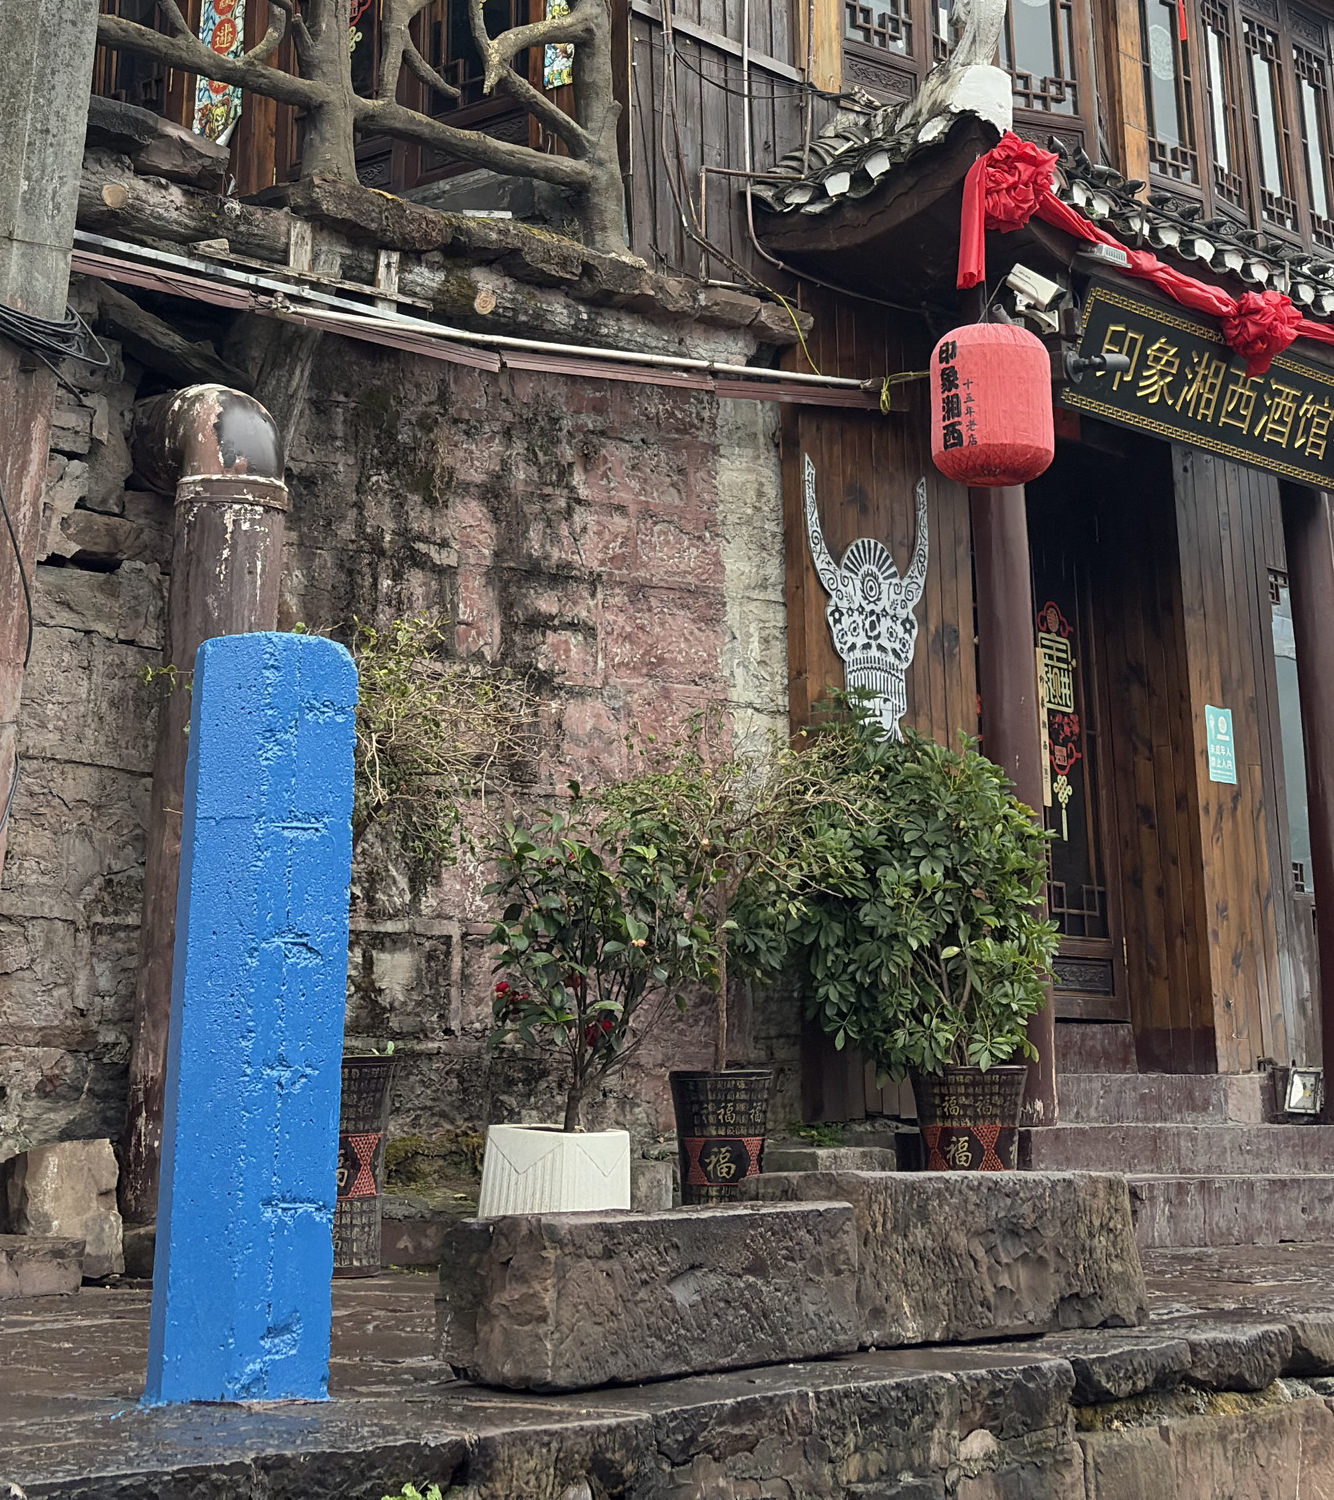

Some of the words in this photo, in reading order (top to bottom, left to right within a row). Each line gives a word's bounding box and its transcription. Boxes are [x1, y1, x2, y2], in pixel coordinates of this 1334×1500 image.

[939, 340, 964, 451] 印象湘西
[962, 378, 978, 447] 十五年老店
[704, 1145, 737, 1180] 福
[945, 1136, 973, 1168] 福
